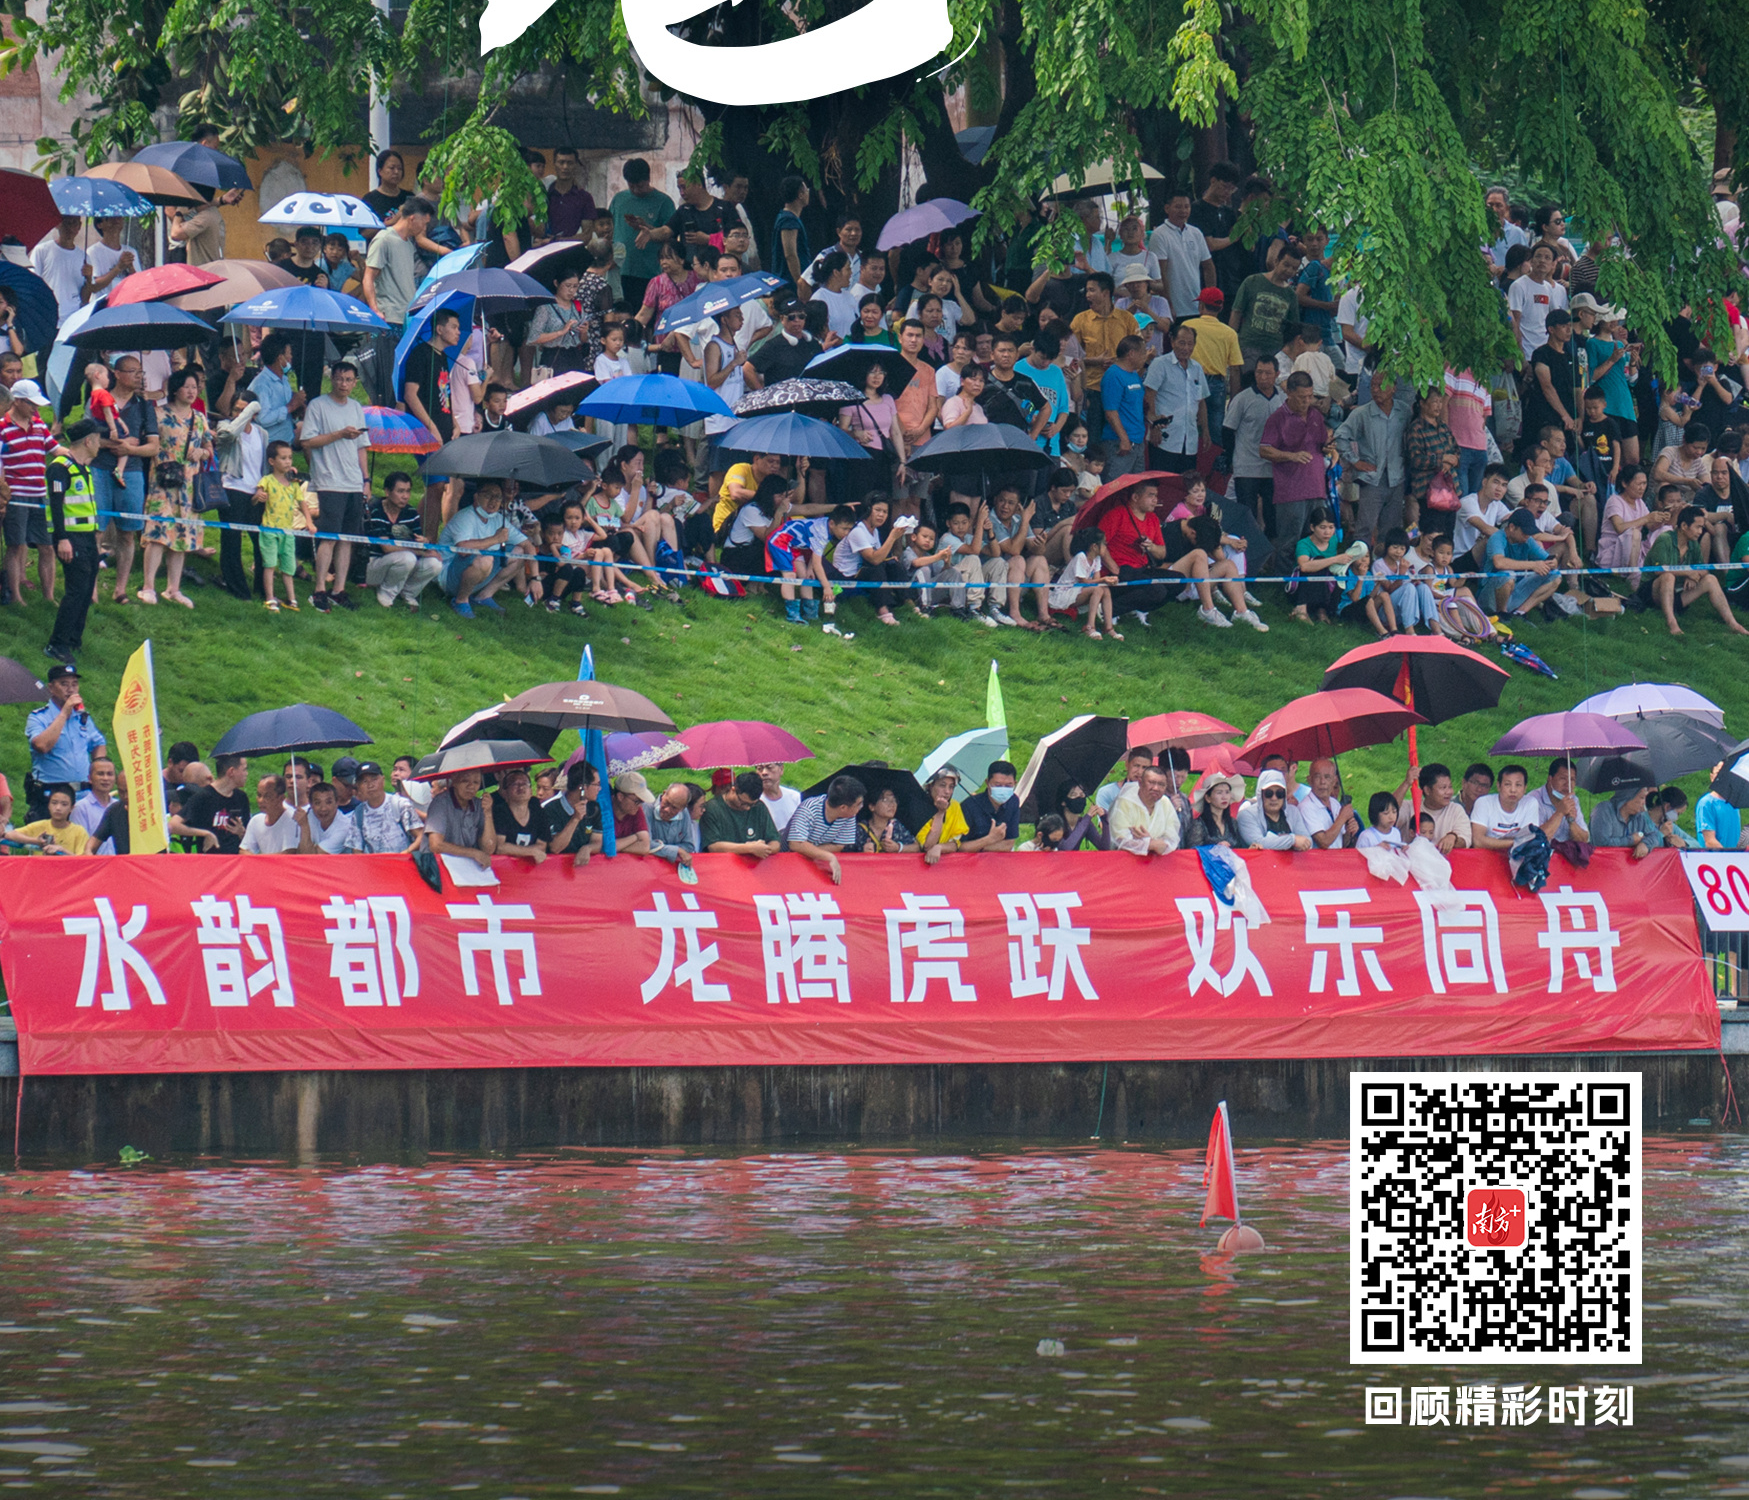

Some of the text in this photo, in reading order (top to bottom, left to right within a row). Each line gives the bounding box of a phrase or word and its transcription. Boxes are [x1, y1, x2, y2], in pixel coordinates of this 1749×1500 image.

[62, 885, 1621, 1011] 水韵都市 龙腾虎跃 欢乐同舟
